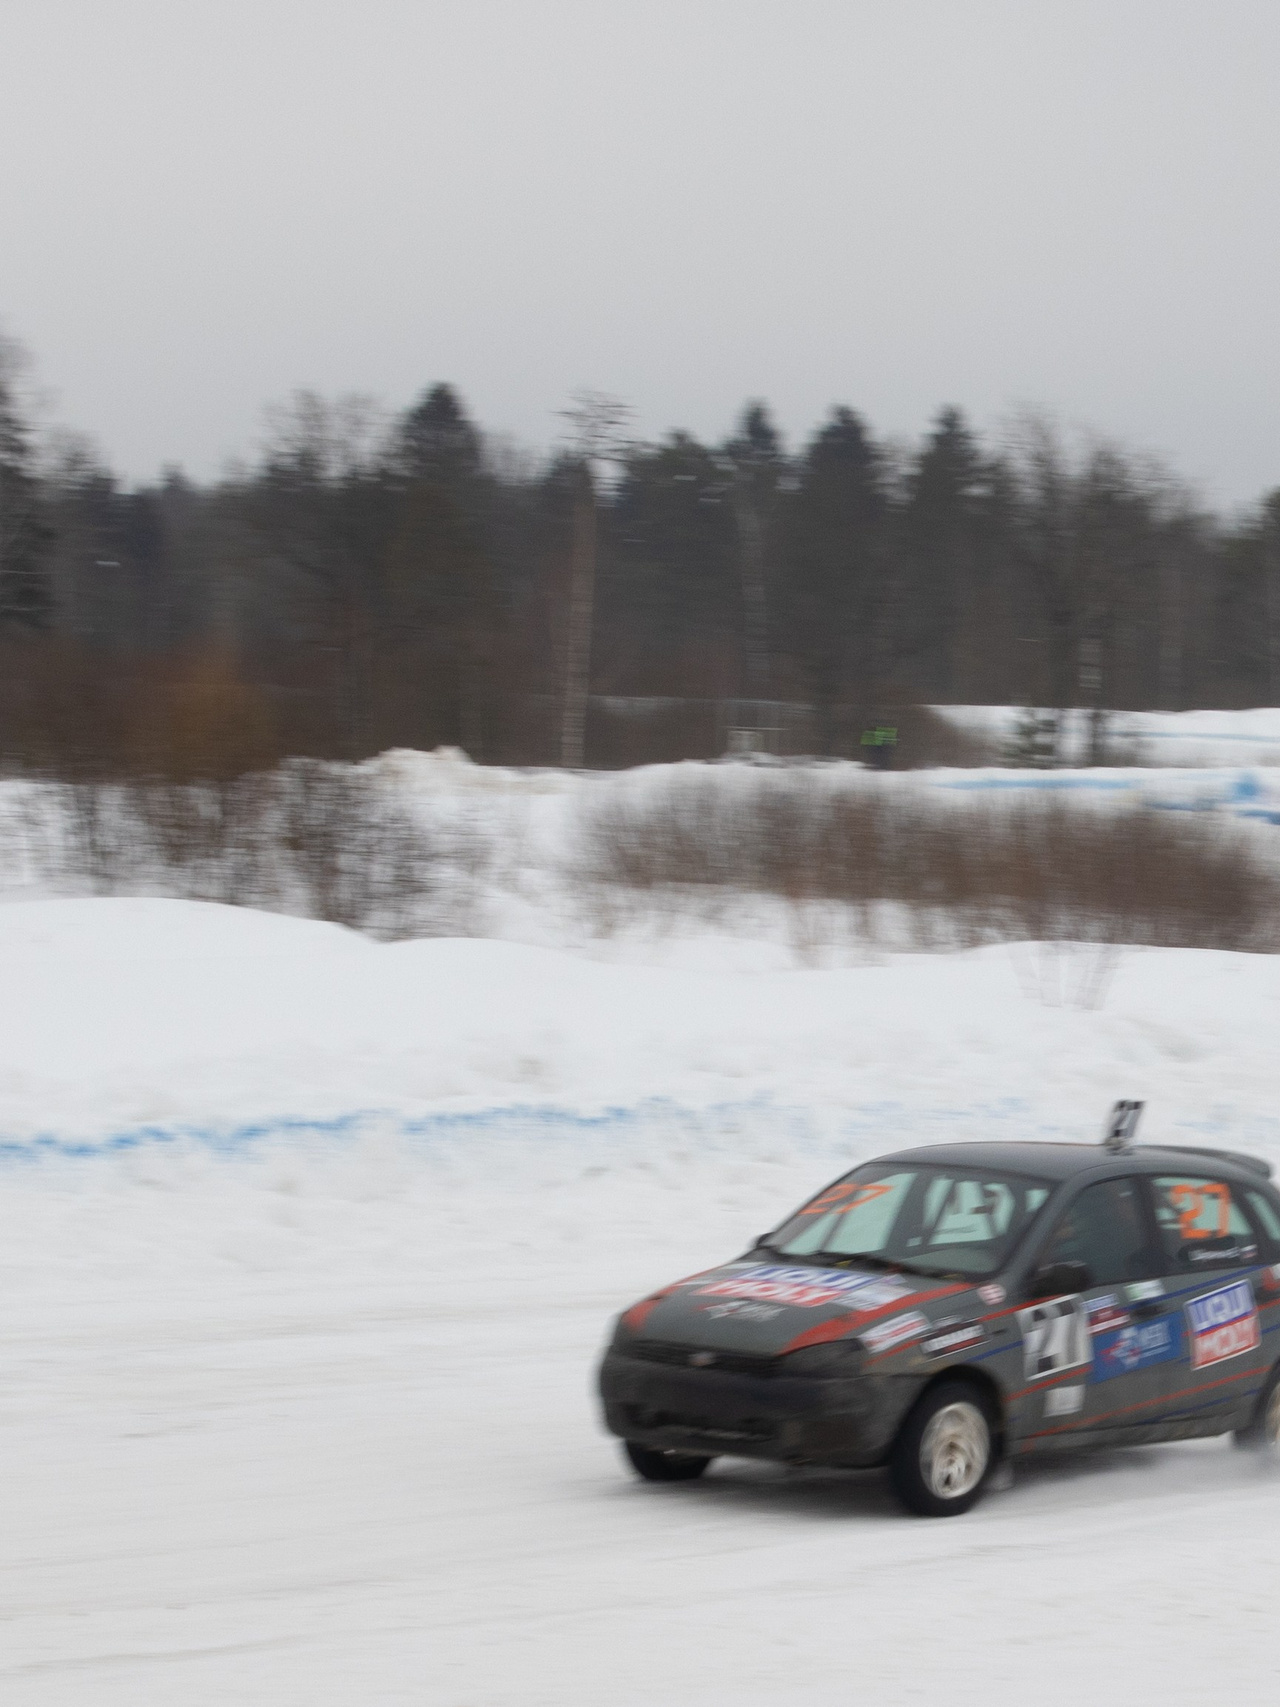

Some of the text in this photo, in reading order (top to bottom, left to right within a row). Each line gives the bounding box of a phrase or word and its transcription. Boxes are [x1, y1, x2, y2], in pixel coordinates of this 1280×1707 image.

[1110, 1100, 1145, 1138] 27
[798, 1184, 894, 1215] 27
[1171, 1183, 1230, 1239] 27
[1024, 1299, 1078, 1374] 27
